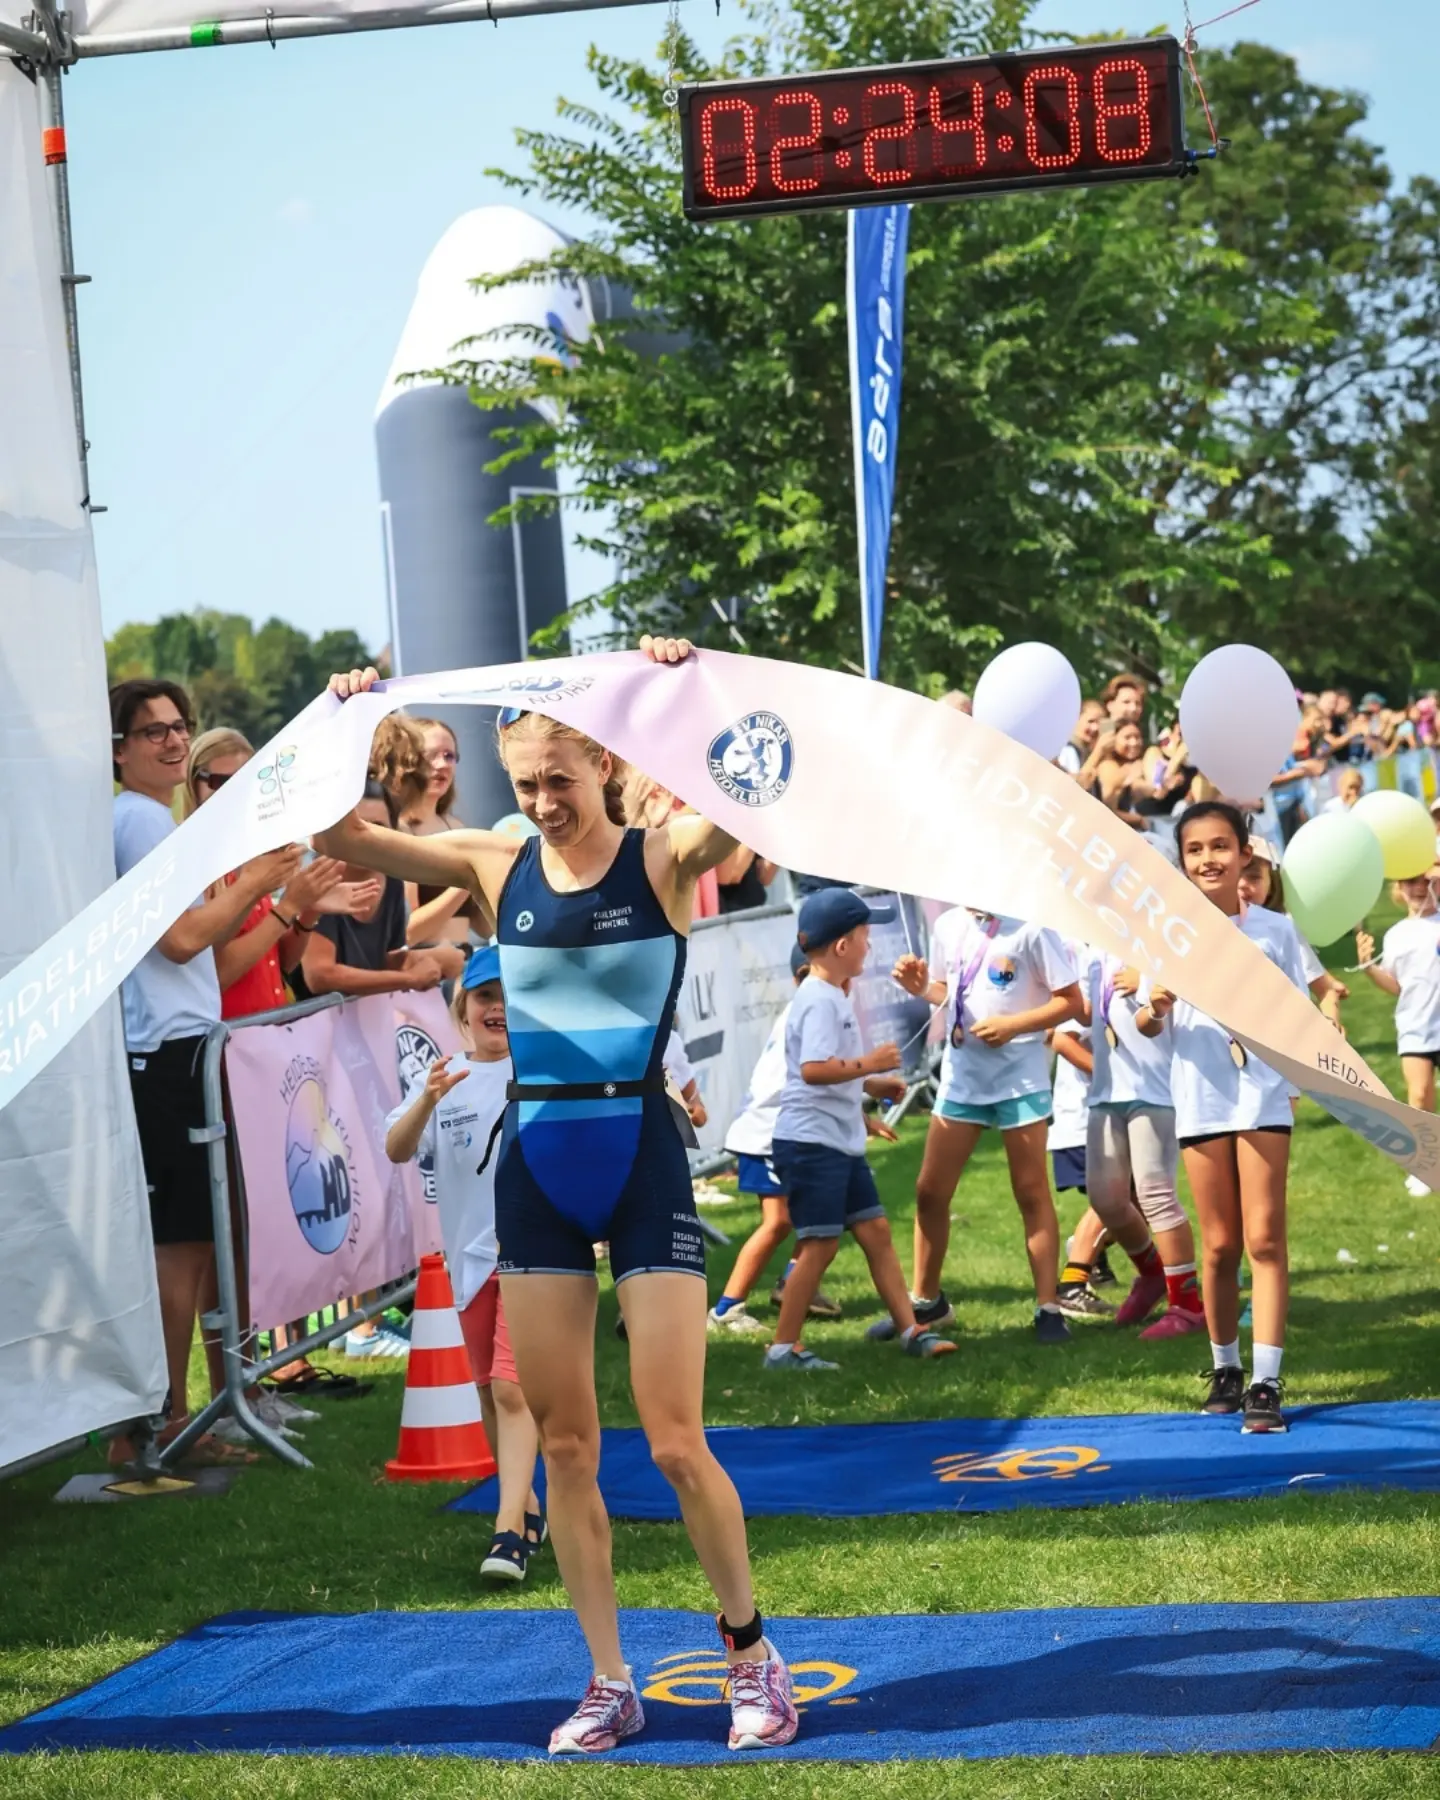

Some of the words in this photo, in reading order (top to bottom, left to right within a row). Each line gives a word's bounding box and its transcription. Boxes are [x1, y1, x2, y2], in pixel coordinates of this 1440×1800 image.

[701, 59, 1151, 199] 02:24:08
[732, 719, 751, 735] SV
[756, 715, 788, 746] NIKAR
[711, 758, 786, 804] HEIDELBERG
[934, 746, 1199, 958] EIDELBERG
